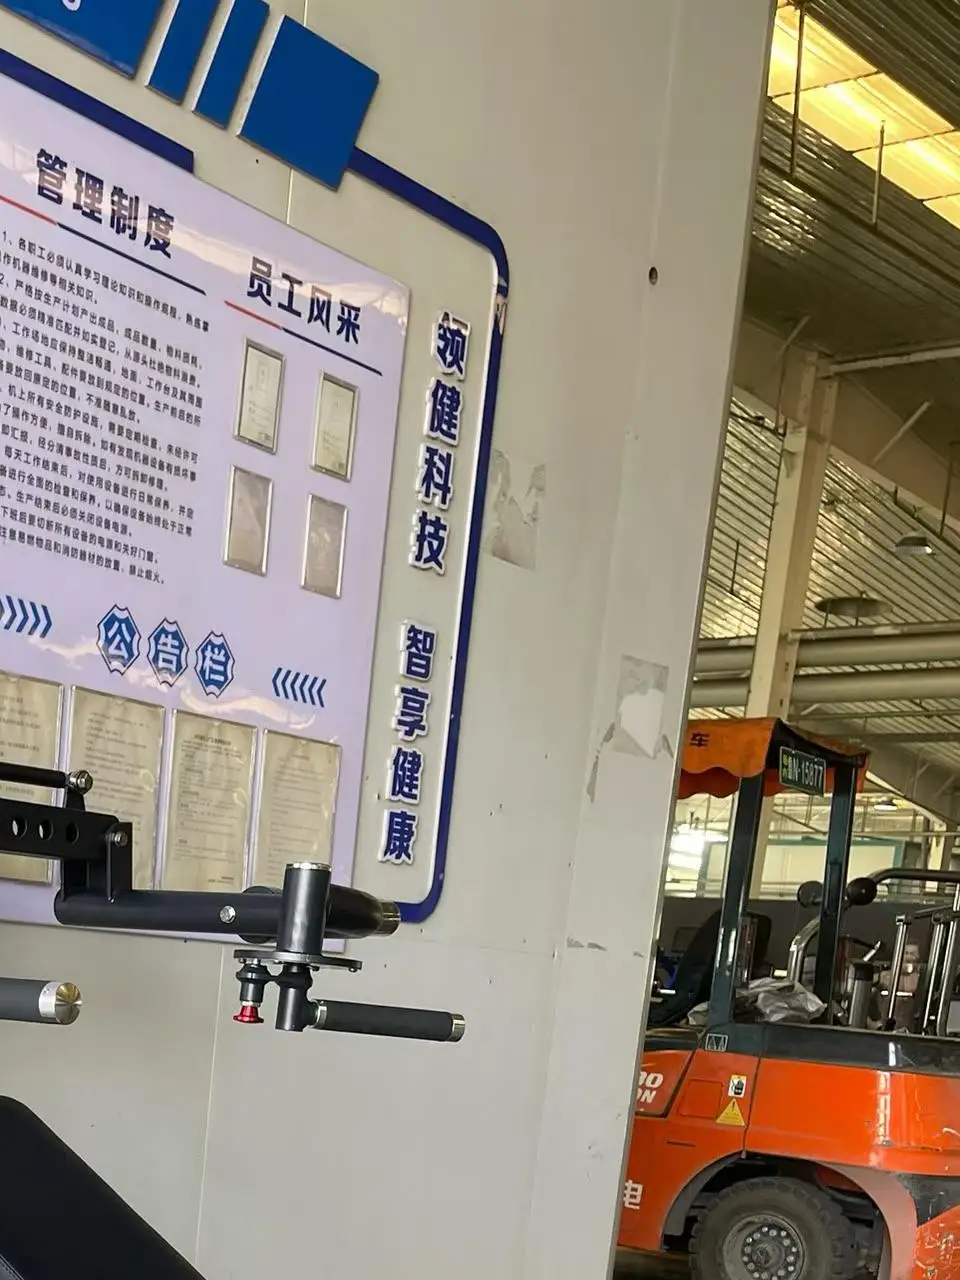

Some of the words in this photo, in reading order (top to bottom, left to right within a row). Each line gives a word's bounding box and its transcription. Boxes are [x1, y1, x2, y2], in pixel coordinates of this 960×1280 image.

[37, 148, 175, 259] 管理制度
[247, 256, 362, 345] 员工风采
[414, 312, 470, 571] 领健科技
[107, 619, 229, 683] 公告栏
[383, 622, 436, 863] 智享健康
[690, 732, 710, 748] 车
